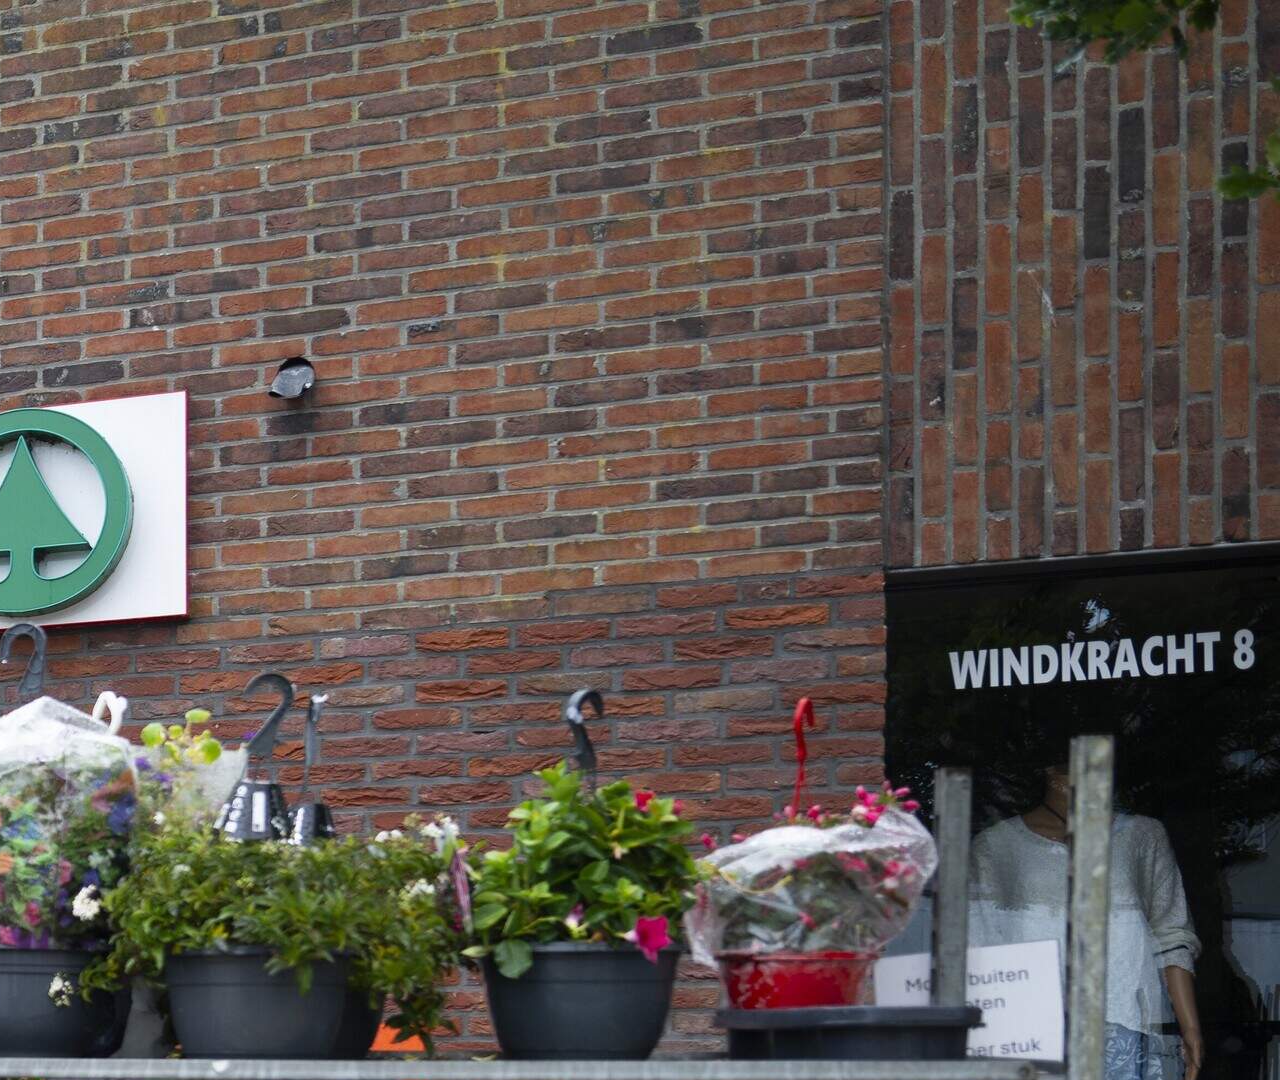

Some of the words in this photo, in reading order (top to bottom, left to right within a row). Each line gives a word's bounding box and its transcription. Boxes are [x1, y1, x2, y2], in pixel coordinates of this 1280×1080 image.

[949, 631, 1220, 689] WINDKRACHT
[1233, 628, 1256, 670] 8
[968, 968, 1029, 986] buiten
[1000, 1038, 1040, 1056] stuk
